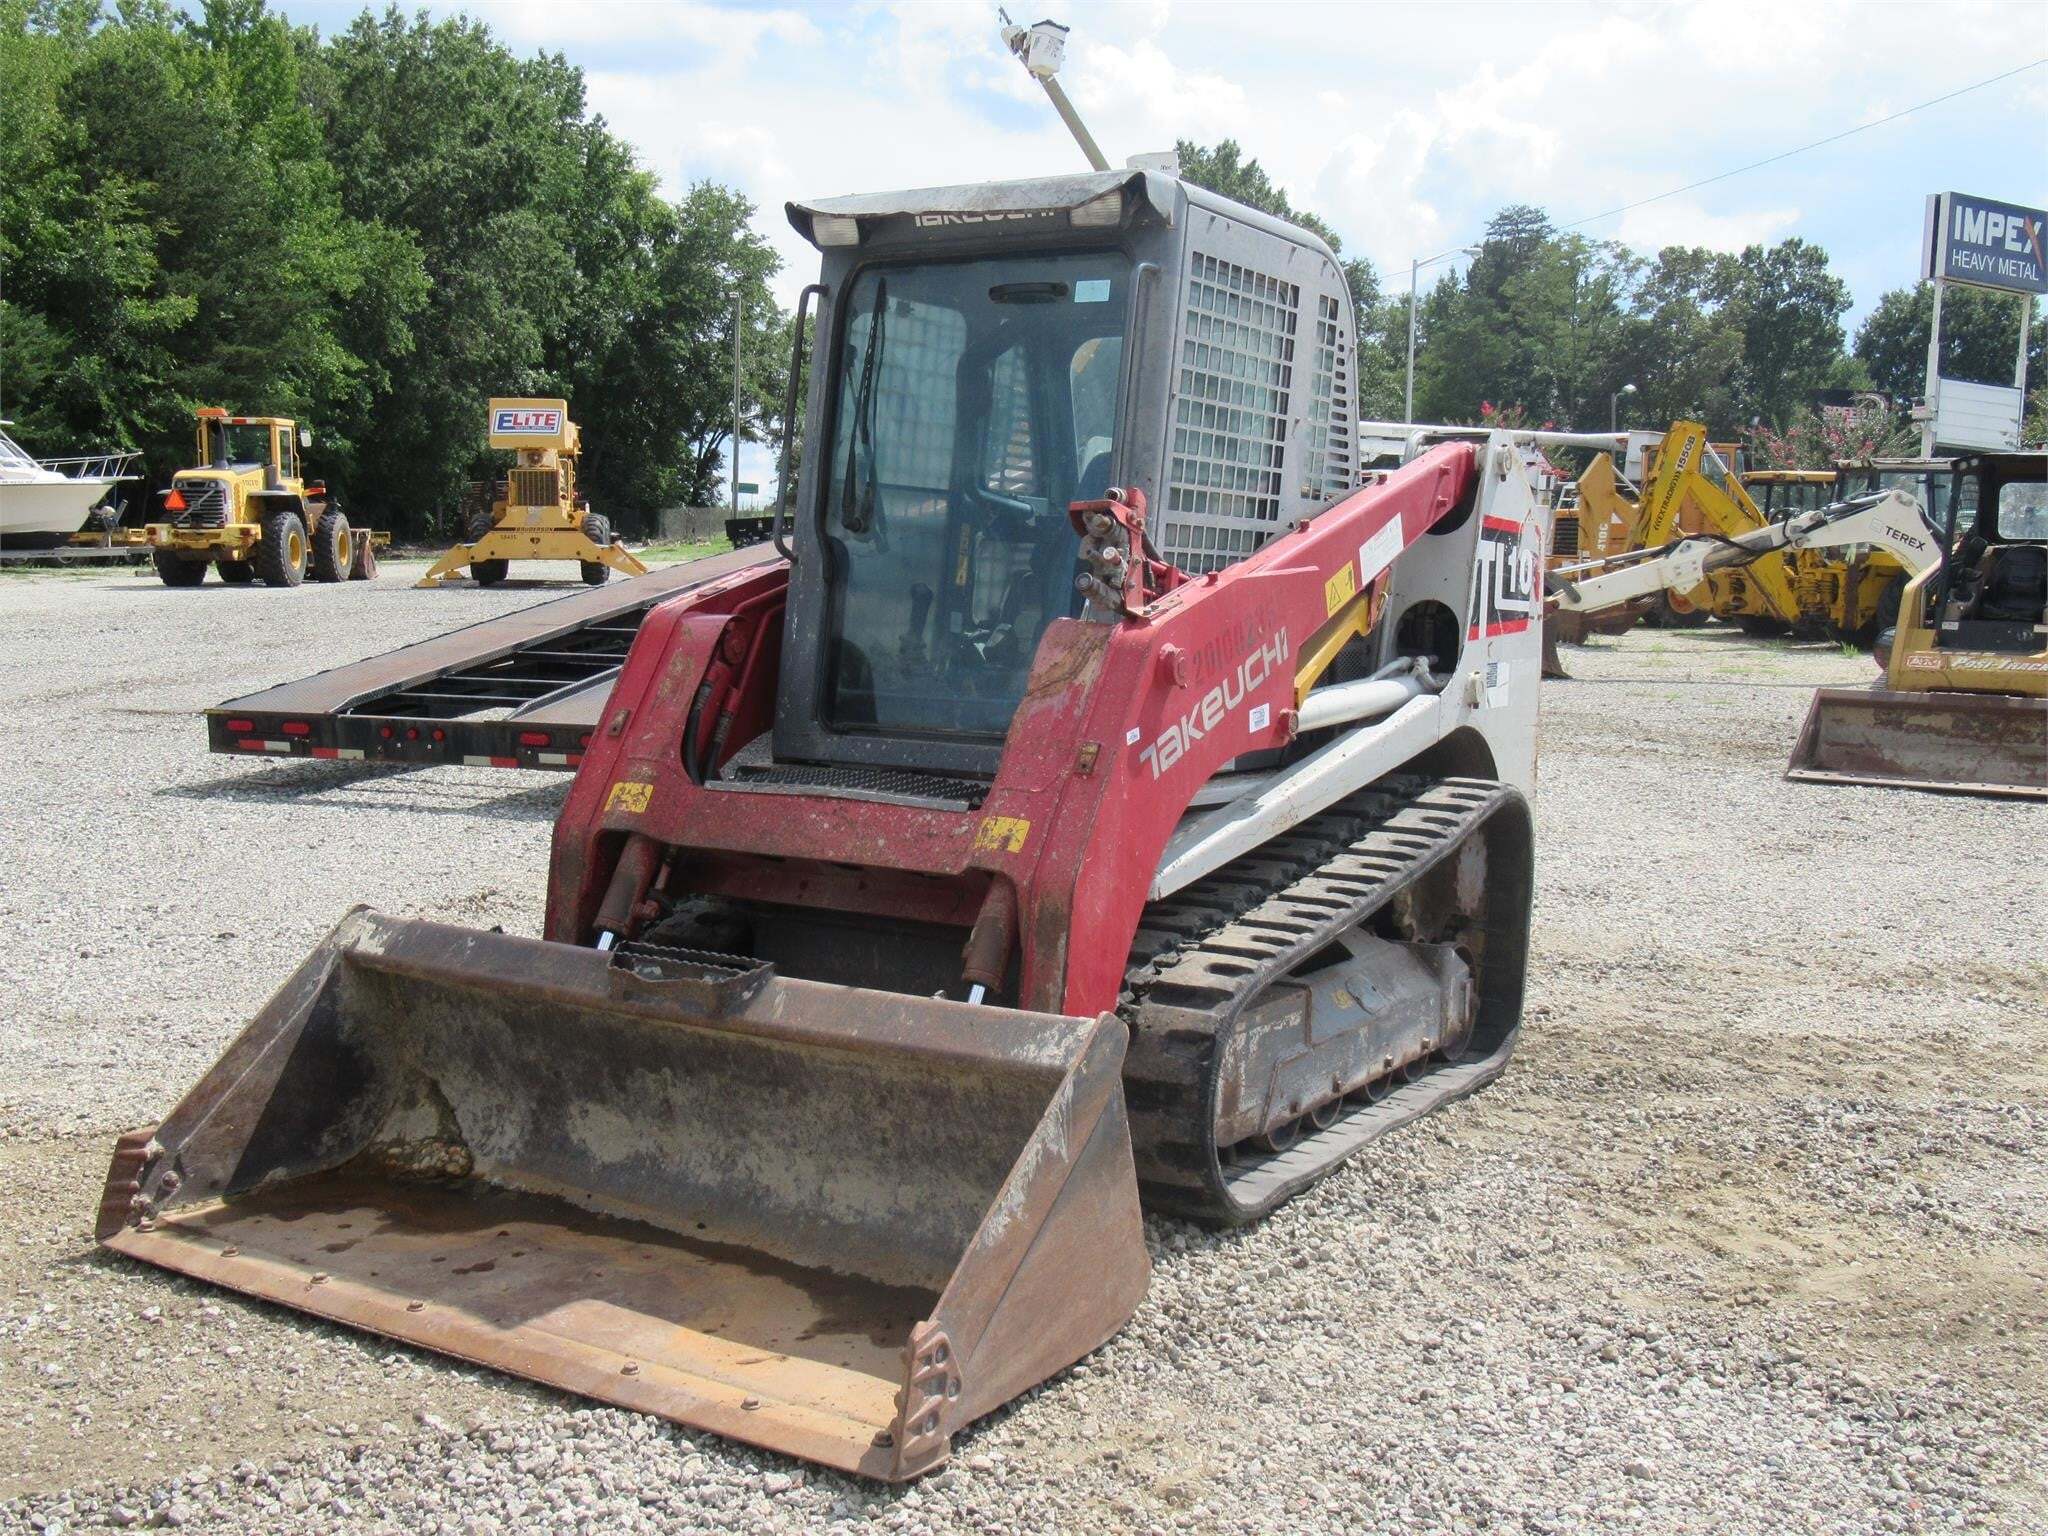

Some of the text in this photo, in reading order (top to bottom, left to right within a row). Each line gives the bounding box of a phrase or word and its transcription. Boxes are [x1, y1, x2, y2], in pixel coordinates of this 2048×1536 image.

[1954, 205, 2042, 254] IMPEX
[1952, 248, 2039, 280] HEAVY METAL
[1678, 435, 1696, 469] 1550B
[1885, 525, 1926, 551] TEREX
